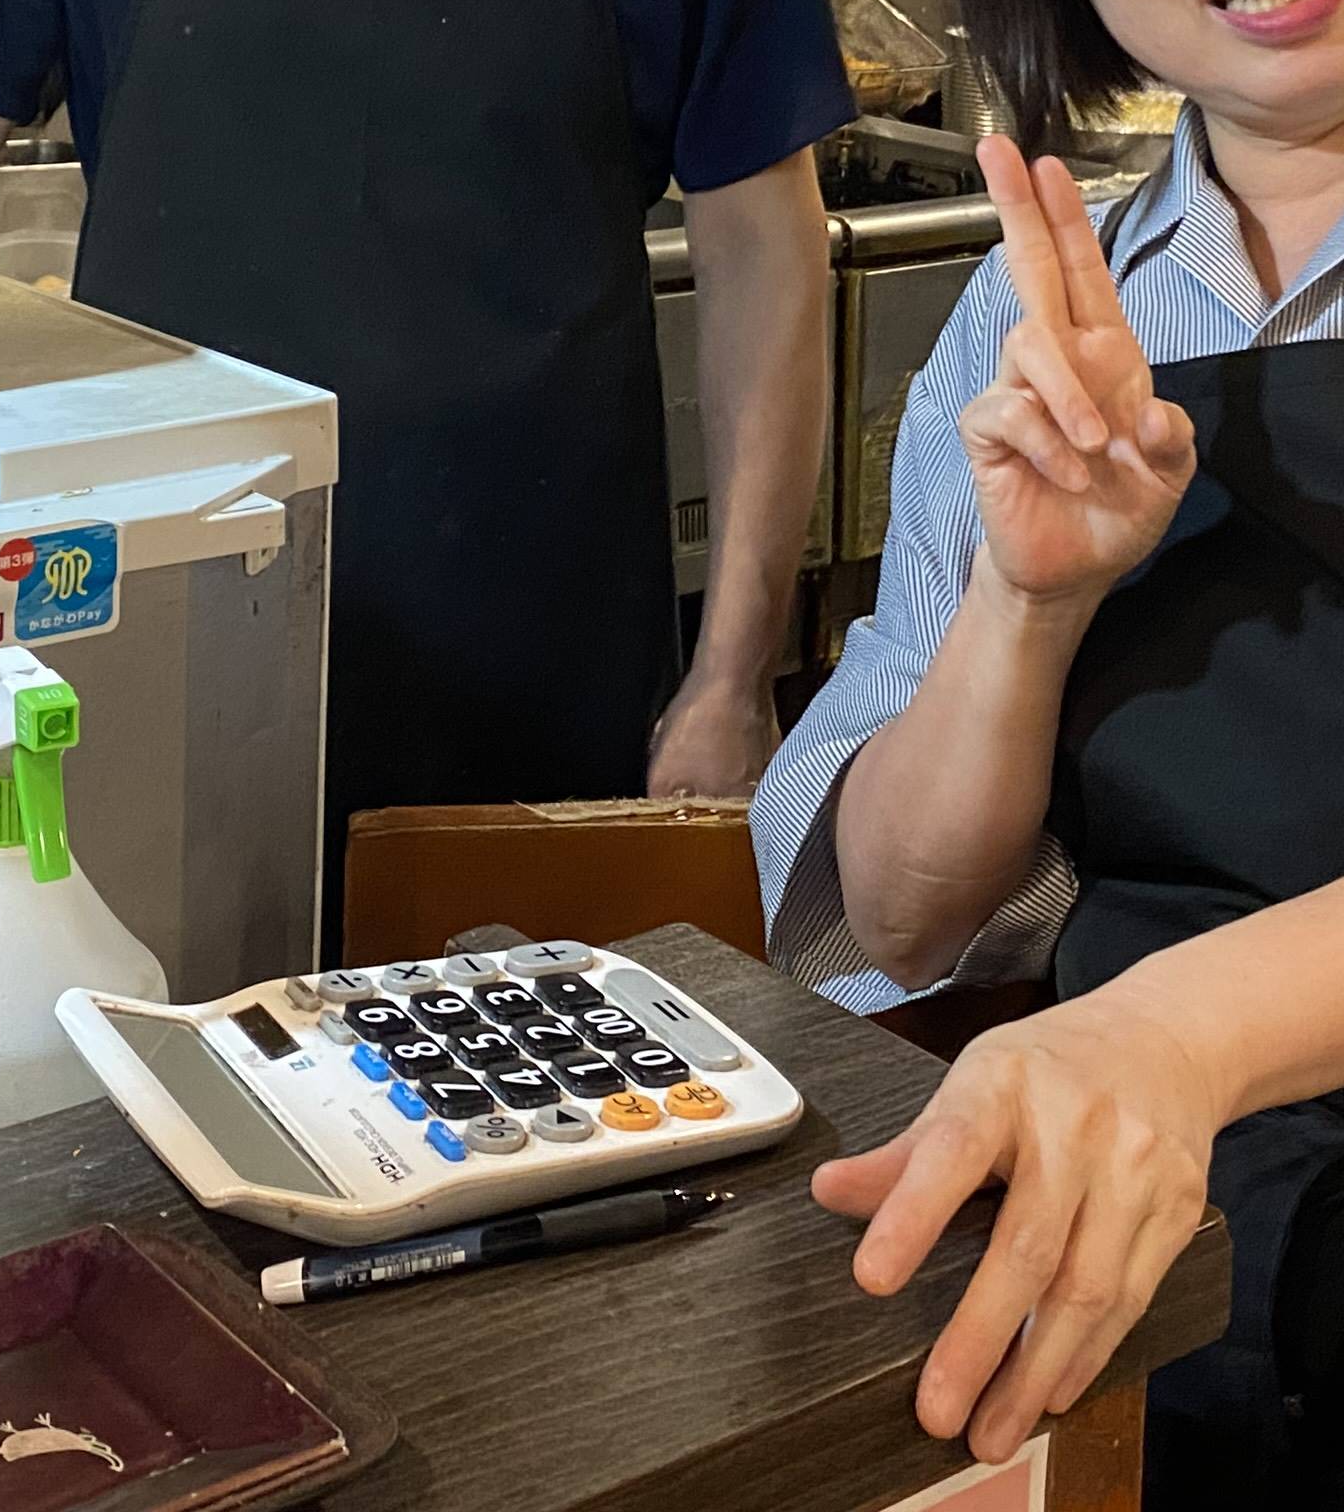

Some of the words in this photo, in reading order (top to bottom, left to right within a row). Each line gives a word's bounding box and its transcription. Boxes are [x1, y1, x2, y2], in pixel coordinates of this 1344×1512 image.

[29, 609, 102, 631] かながわPay
[425, 997, 467, 1013] 6
[490, 988, 534, 1004] 3
[358, 1006, 405, 1024] 9
[583, 1008, 638, 1036] 00
[527, 1021, 576, 1041] 2
[399, 1041, 440, 1059] 8
[459, 1032, 509, 1051] 5
[630, 1048, 675, 1067] 0
[498, 1068, 546, 1086] 4
[431, 1082, 483, 1100] 7
